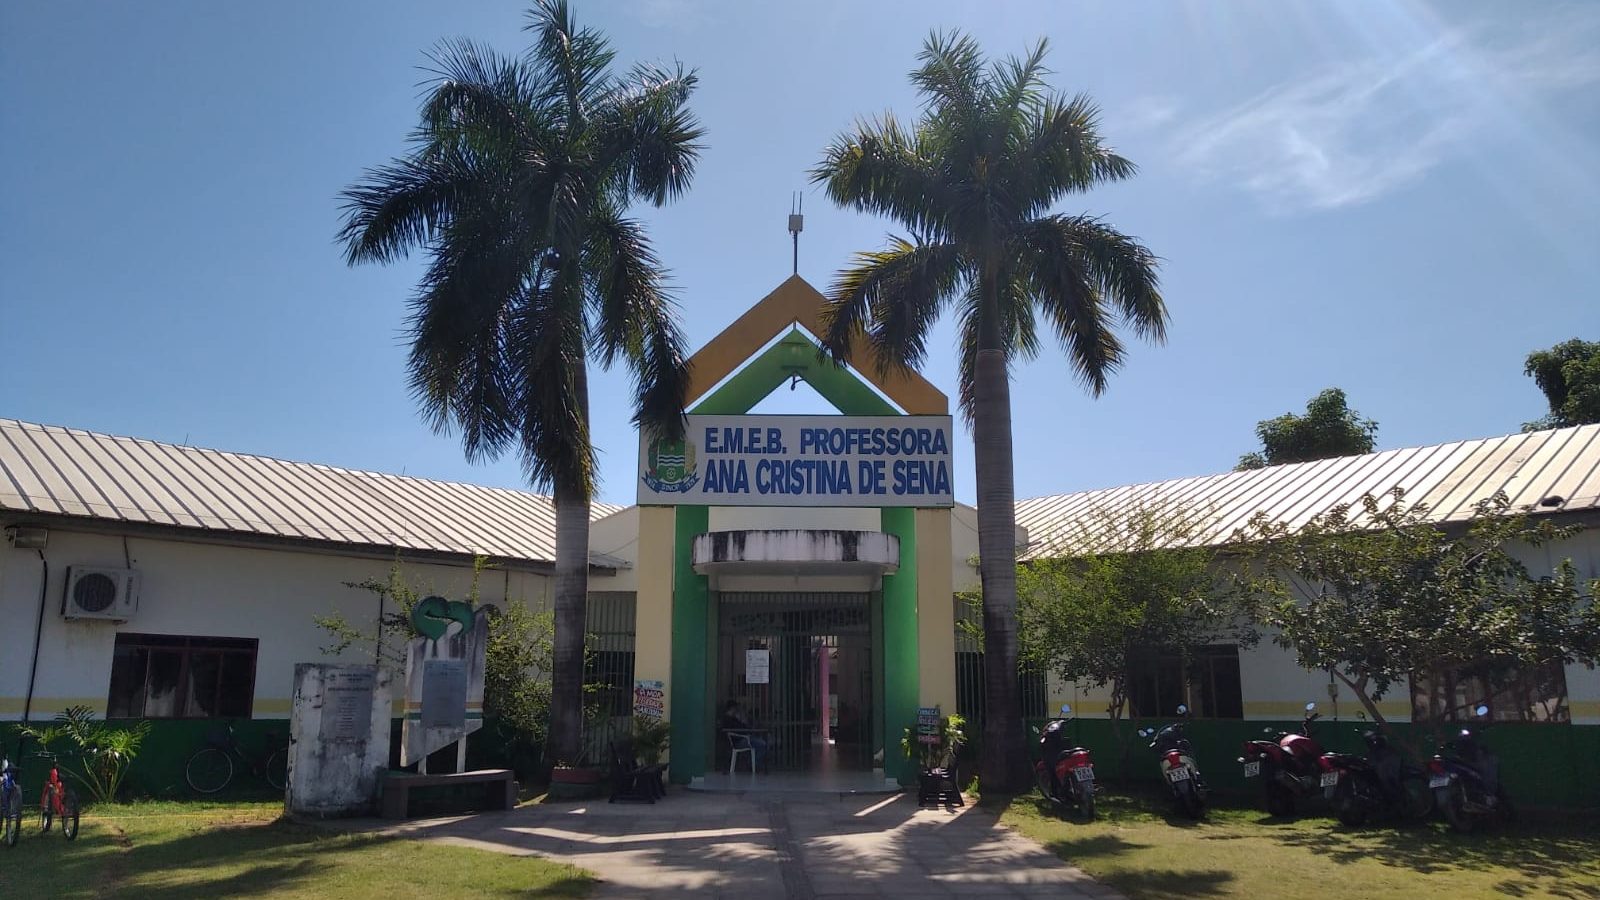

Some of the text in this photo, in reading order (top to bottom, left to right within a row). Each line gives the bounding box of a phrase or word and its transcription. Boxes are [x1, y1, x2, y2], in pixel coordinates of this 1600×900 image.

[705, 427, 949, 455] E.M.E.B. PROFESSORA
[702, 458, 951, 495] ANA CRISTINA DE SENA
